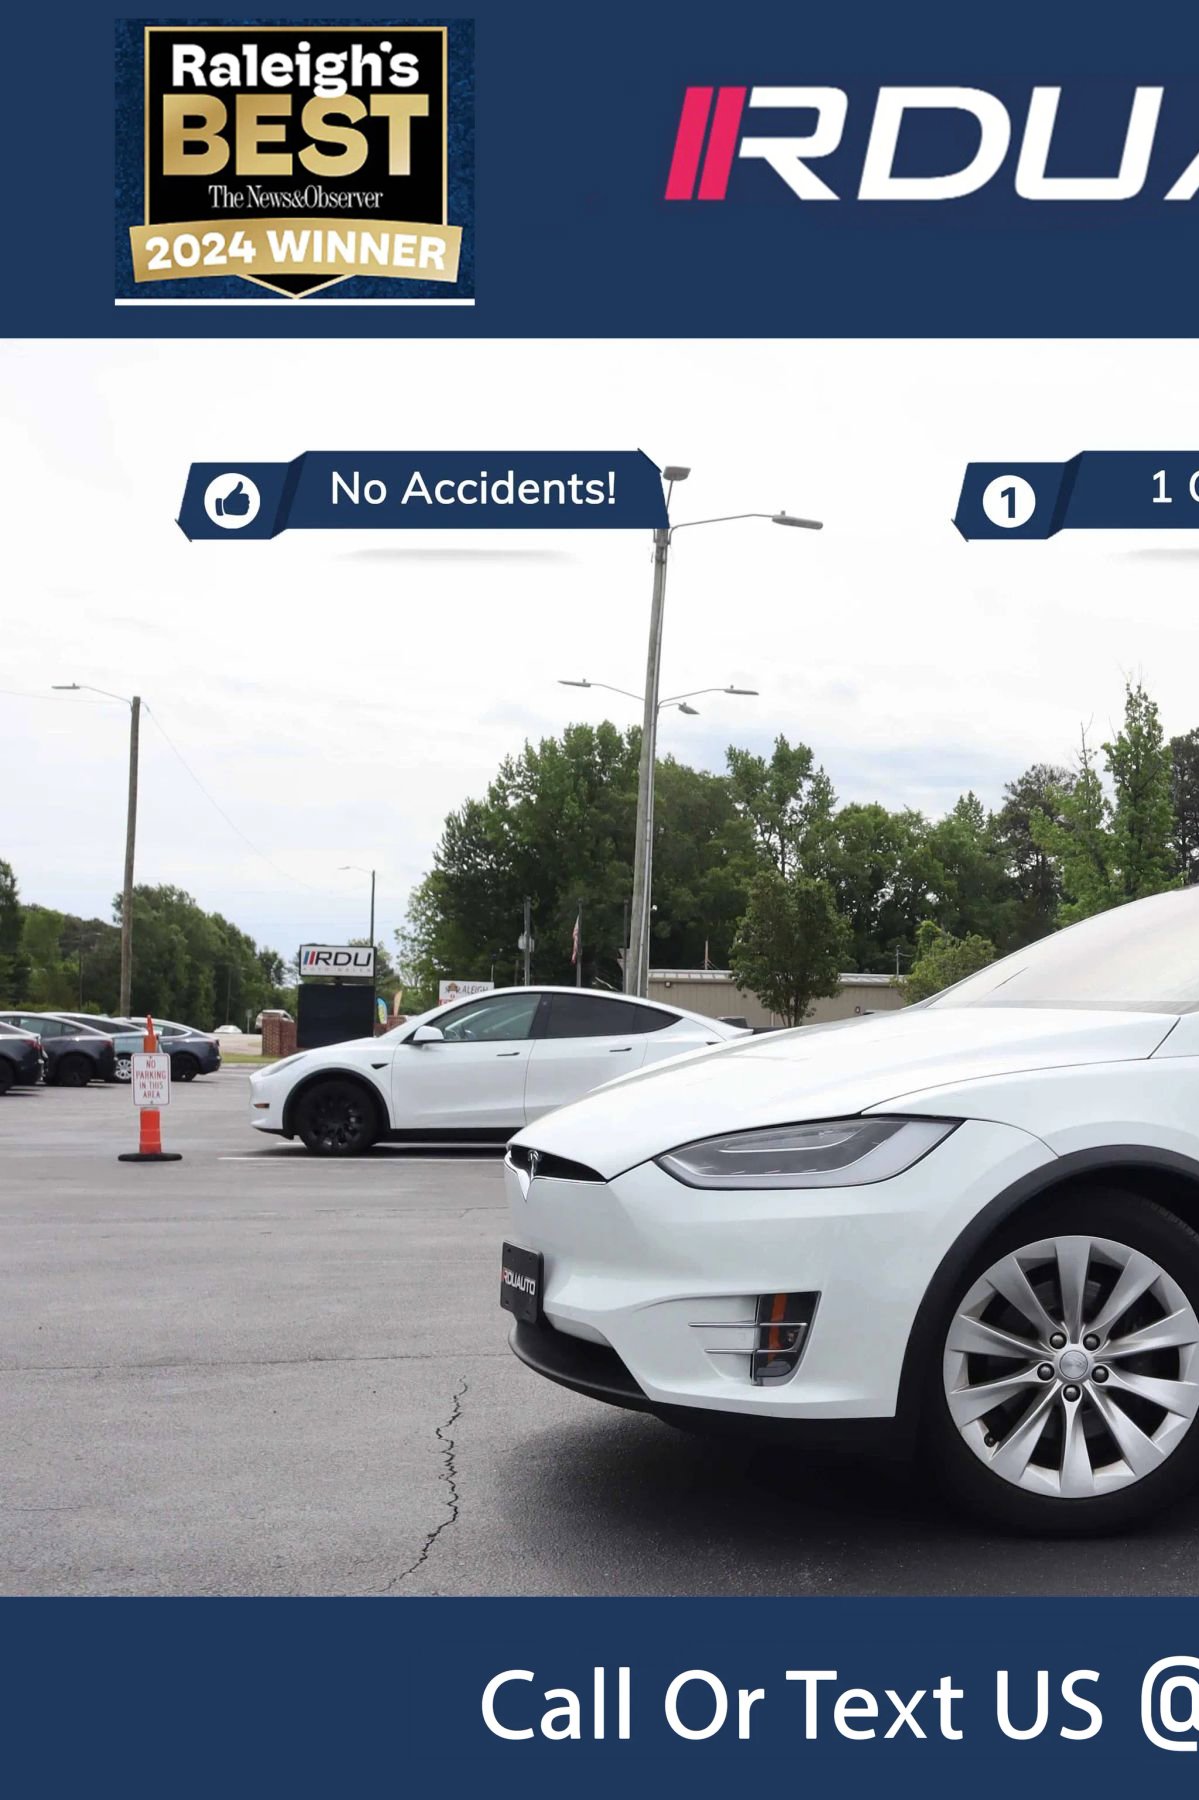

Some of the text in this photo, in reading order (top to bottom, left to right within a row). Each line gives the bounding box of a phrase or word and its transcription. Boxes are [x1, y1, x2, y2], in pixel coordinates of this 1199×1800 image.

[315, 951, 371, 967] RDU
[146, 1060, 156, 1069] NO
[136, 1071, 167, 1080] PARKING
[140, 1081, 164, 1089] IN THIS
[143, 1090, 161, 1099] AREA
